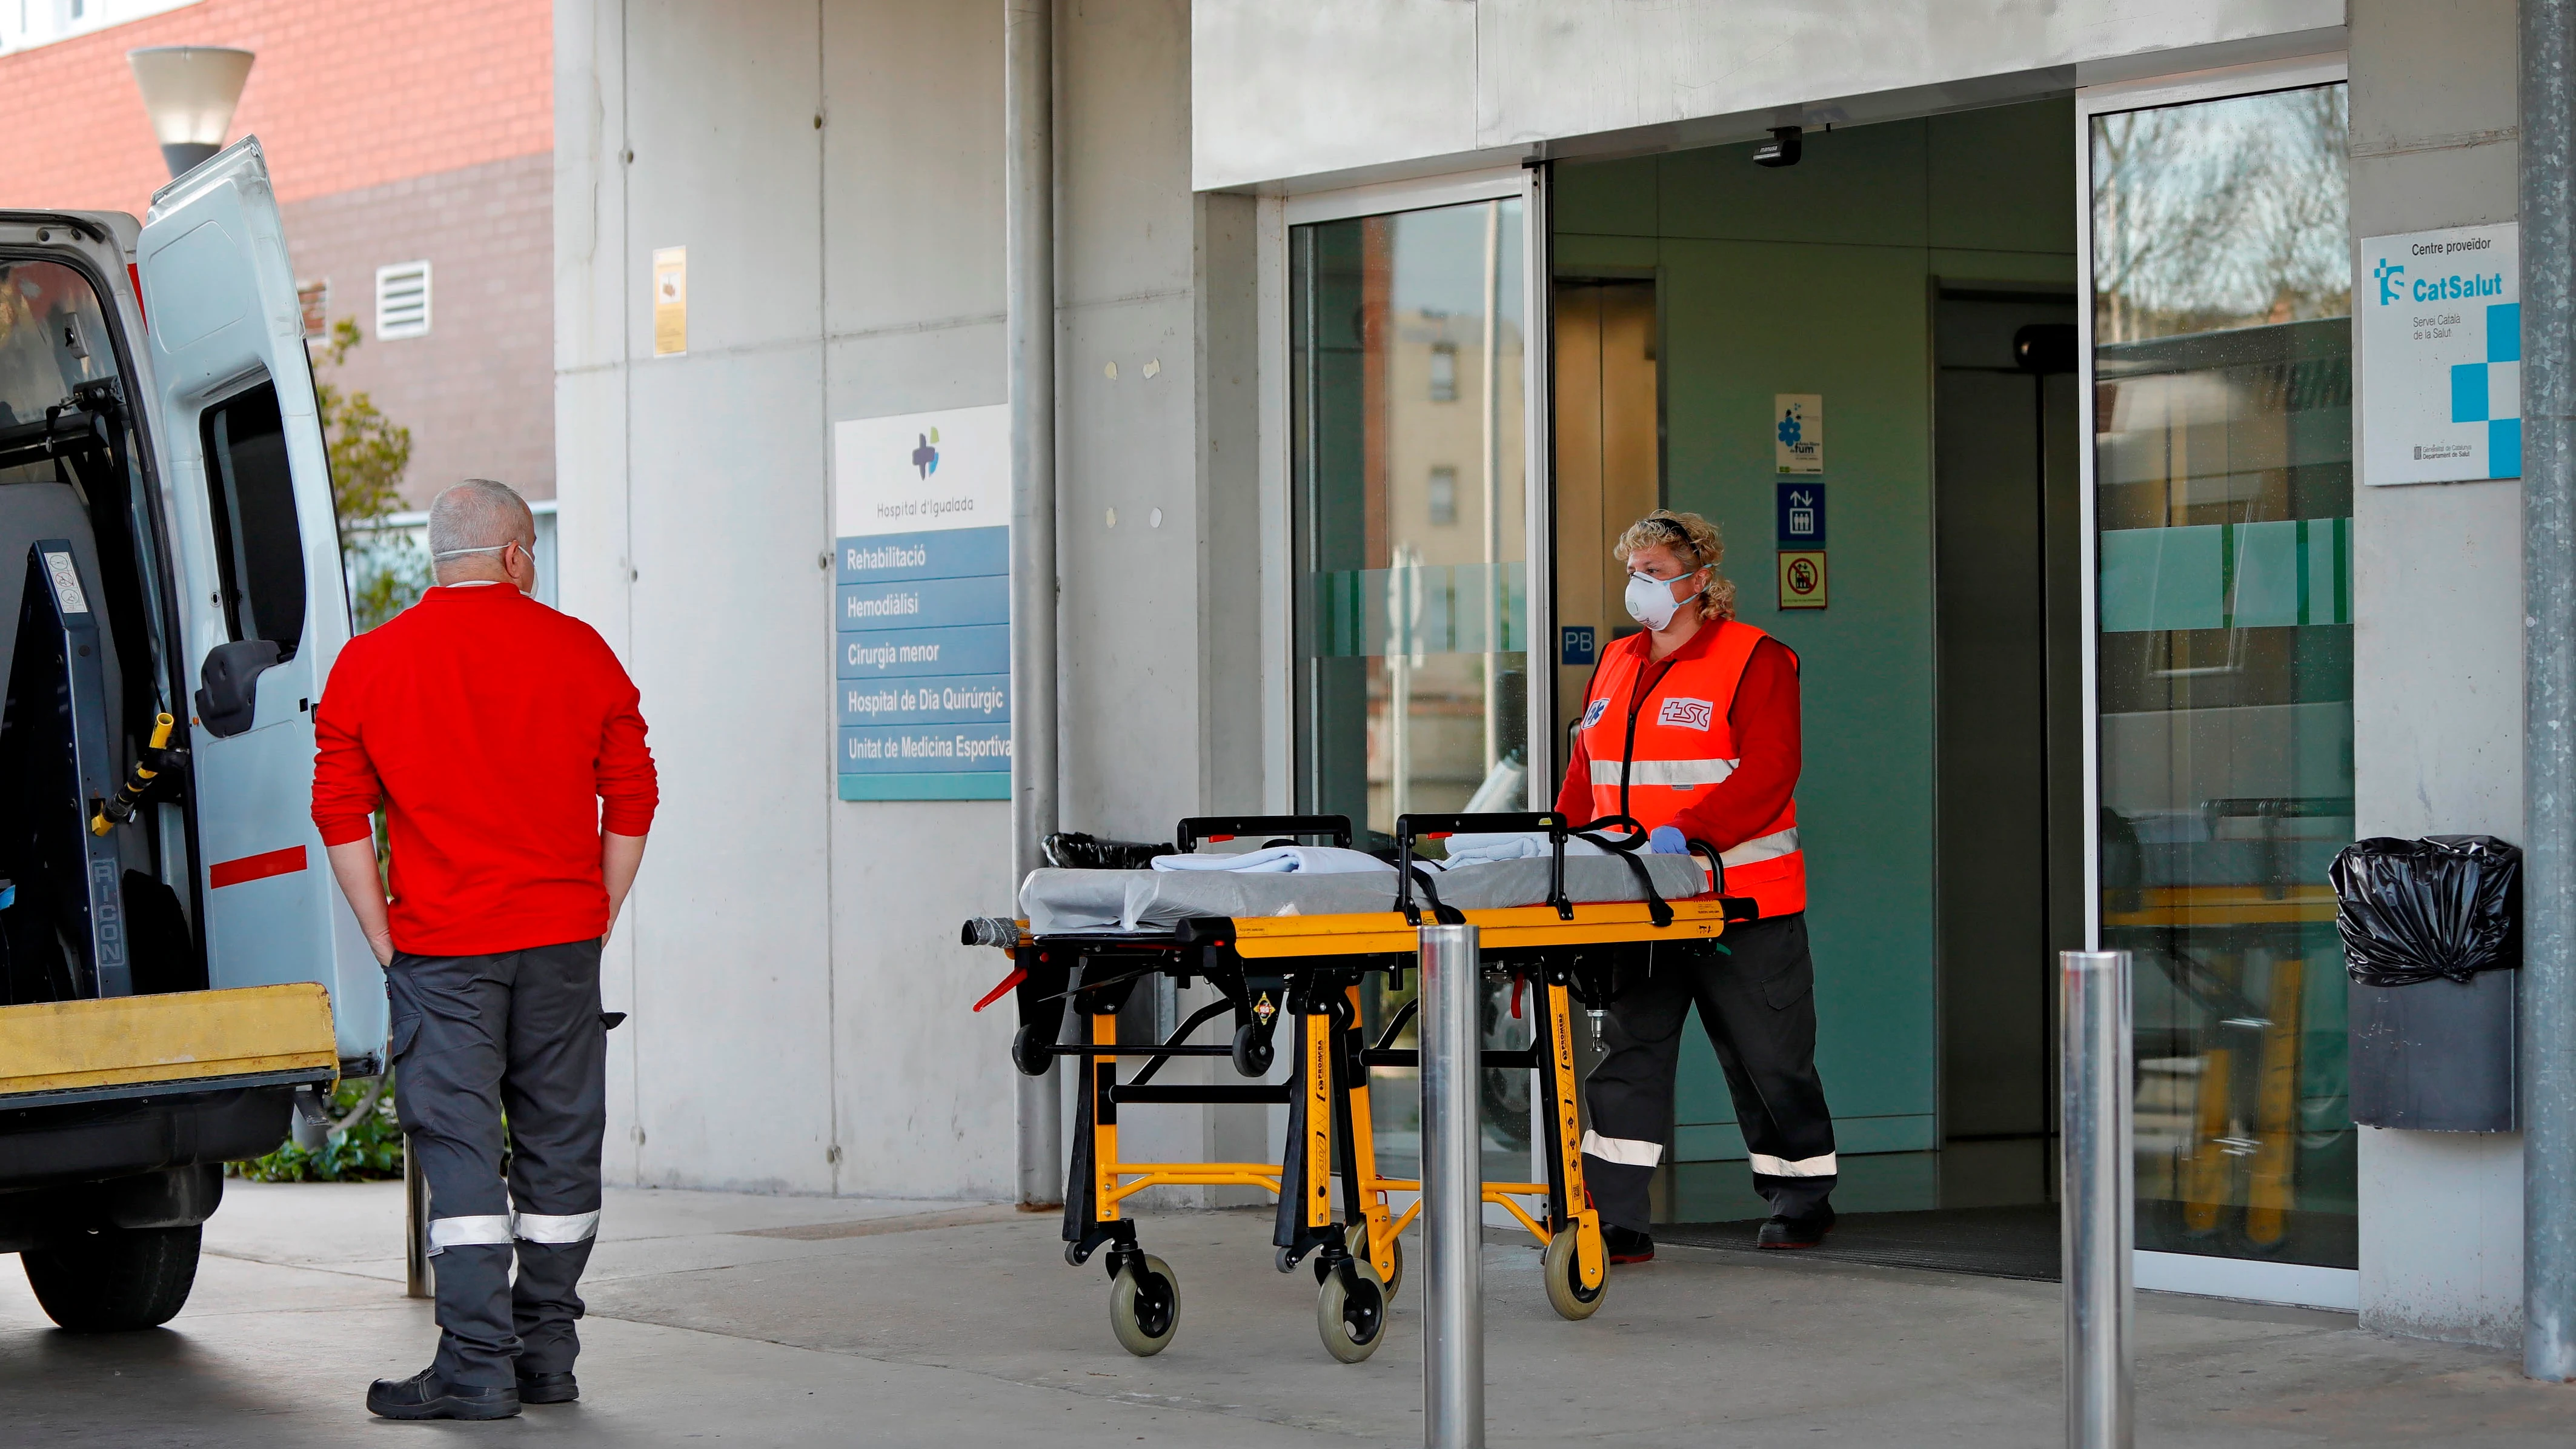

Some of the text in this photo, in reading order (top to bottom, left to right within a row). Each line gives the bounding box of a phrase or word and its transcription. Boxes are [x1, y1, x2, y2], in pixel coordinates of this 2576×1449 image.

[2412, 238, 2491, 256] Centre proveïdor
[2413, 273, 2502, 302] CatSalut
[2413, 313, 2461, 327] Servei Català
[2414, 328, 2451, 340] de la Salut
[1795, 442, 1814, 453] fum
[877, 496, 973, 520] Hospital d'Igualada
[848, 544, 926, 570] Rehabilitació
[848, 592, 918, 618] Hemodiàlisi
[1565, 632, 1593, 652] PB
[848, 643, 940, 669] Cirurgia menor
[848, 686, 1003, 717] Hospital de Dia Quirúrgic
[849, 735, 1013, 762] Unitat de Medicina Esportiva
[95, 866, 121, 961] RICON
